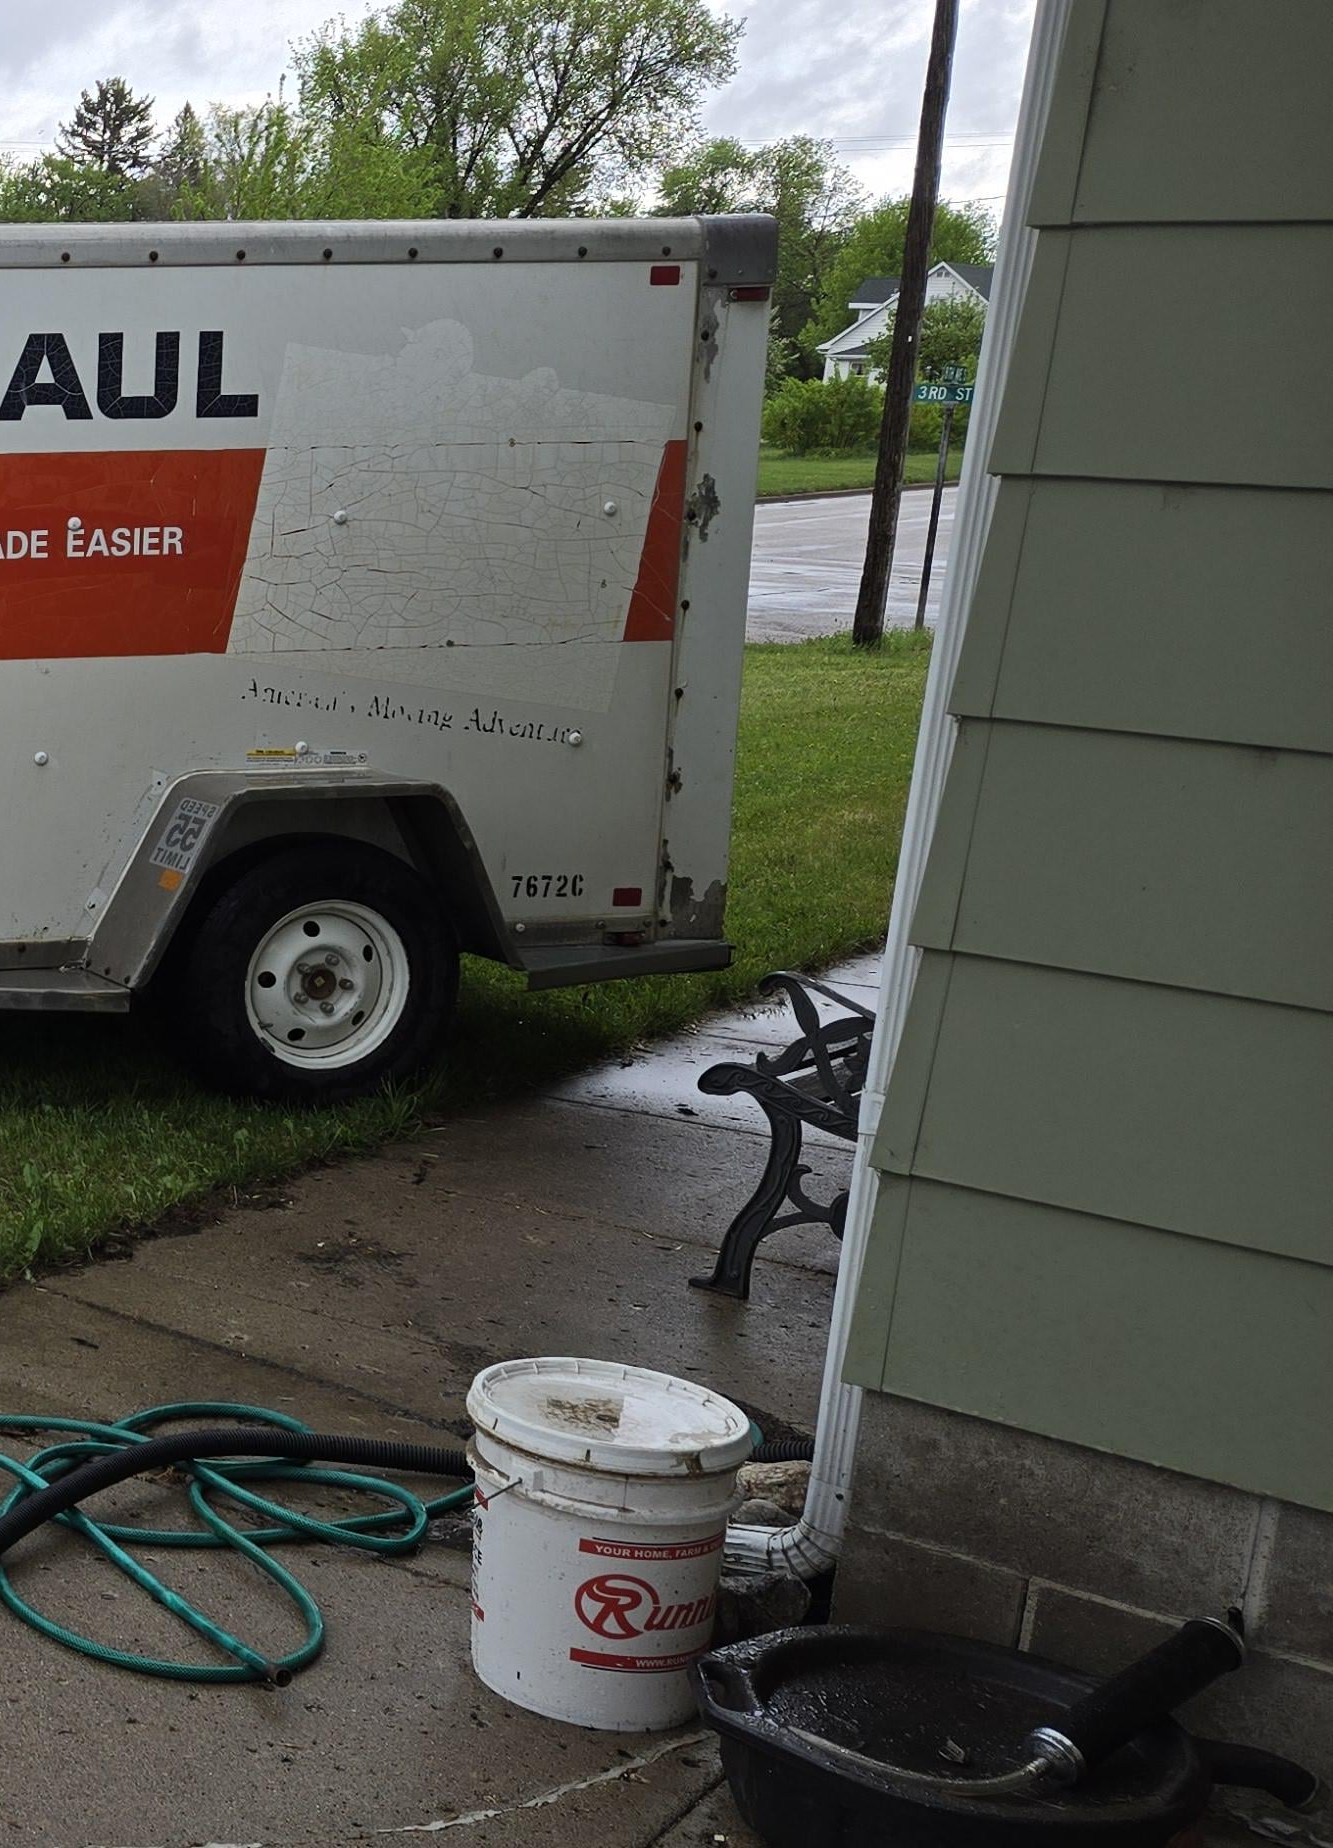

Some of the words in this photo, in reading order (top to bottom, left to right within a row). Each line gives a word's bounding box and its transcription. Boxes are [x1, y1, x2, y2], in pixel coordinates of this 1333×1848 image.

[917, 385, 947, 400] 3RD
[955, 387, 973, 401] ST
[66, 526, 184, 559] EASIER
[595, 1544, 631, 1557] YOUR
[634, 1549, 673, 1559] HOME,
[675, 1545, 703, 1558] FARM
